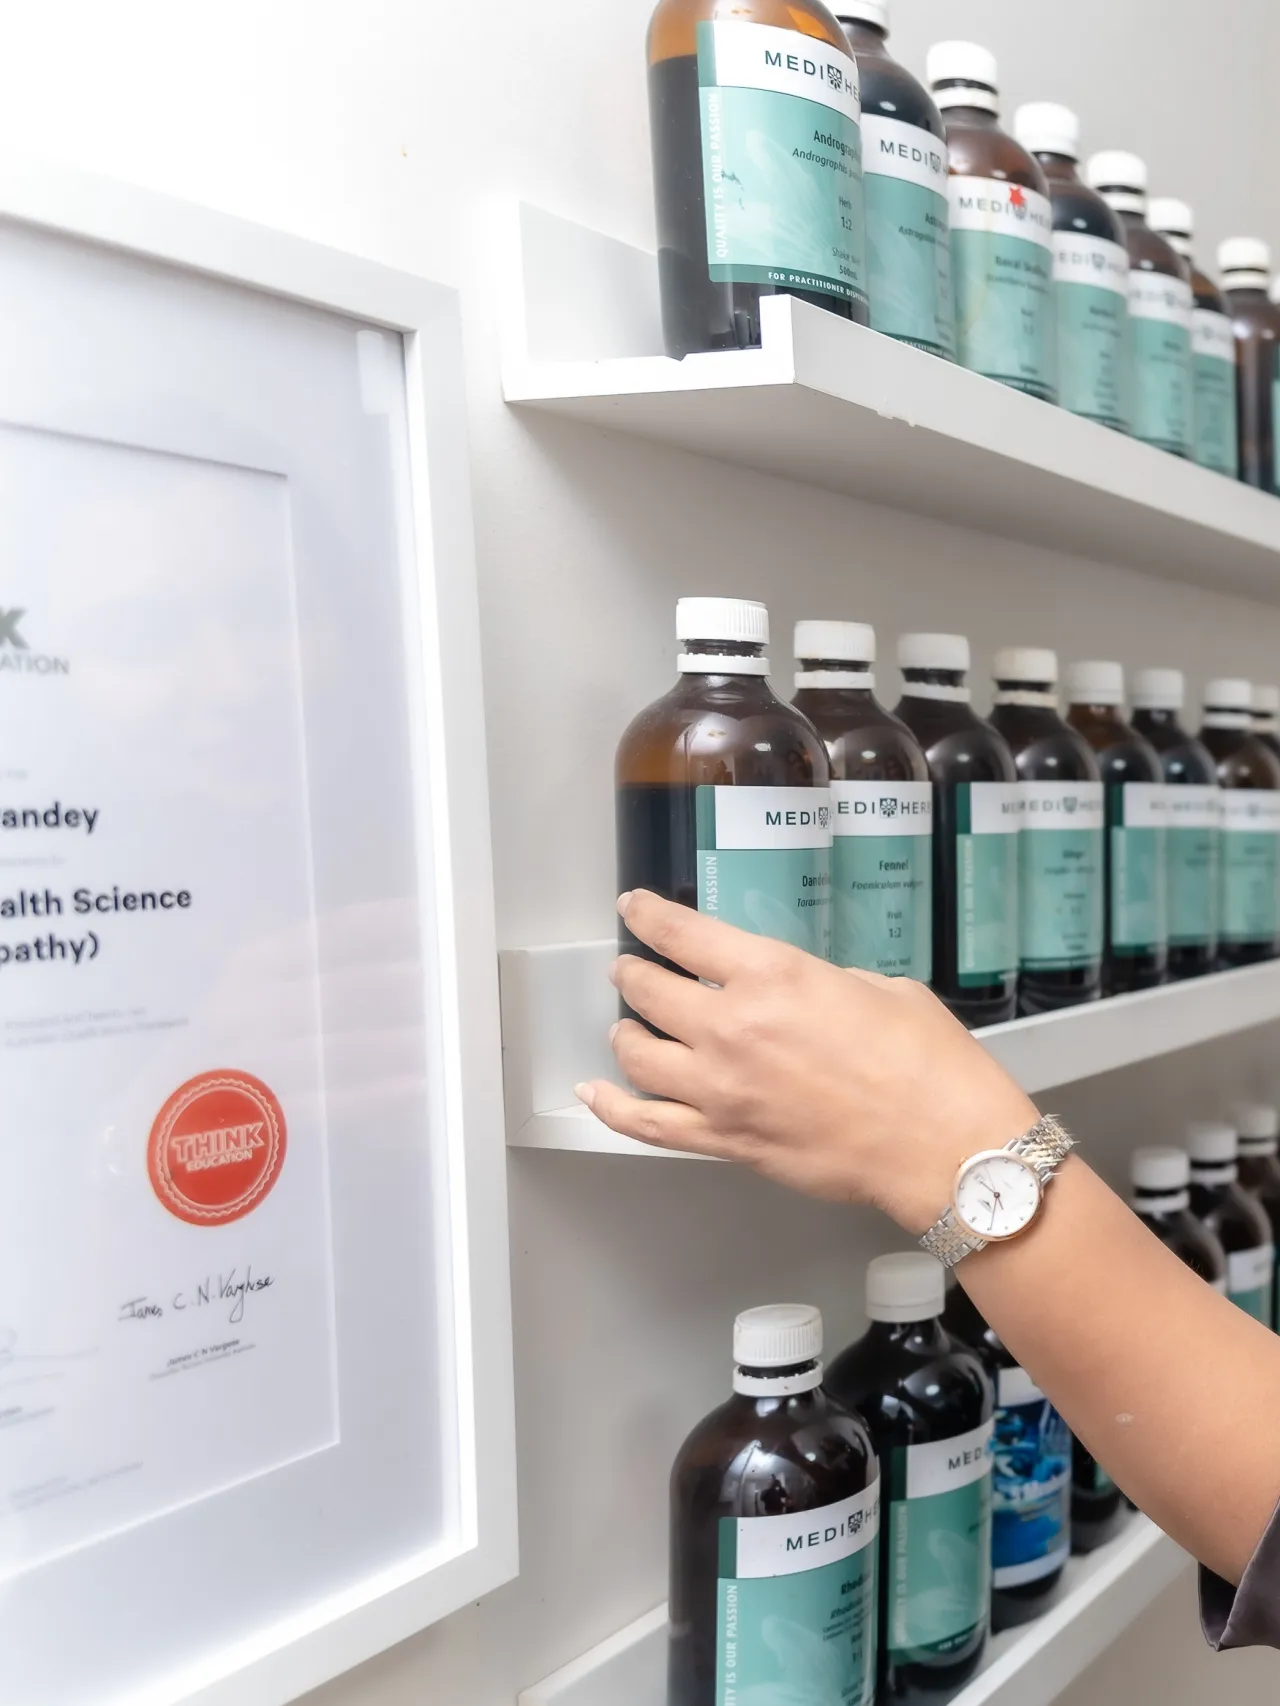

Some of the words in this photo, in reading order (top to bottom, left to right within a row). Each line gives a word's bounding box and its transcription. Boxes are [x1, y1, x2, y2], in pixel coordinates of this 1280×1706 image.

[765, 49, 824, 80] MEDI
[845, 78, 861, 102] HE
[707, 93, 722, 151] PASSION
[880, 138, 928, 168] MEDI
[711, 155, 723, 183] OUR
[713, 187, 724, 199] IS
[959, 196, 1010, 216] MEDI
[713, 204, 729, 258] QUALITY
[768, 271, 786, 281] FOR
[789, 274, 845, 294] PRACTITIONER
[766, 811, 816, 826] MEDI
[838, 801, 875, 814] EDI
[879, 860, 909, 871] Fennel
[705, 856, 718, 910] PASSION
[73, 886, 192, 914] Science
[171, 1122, 264, 1164] THINK
[186, 1149, 253, 1173] EDUCATION
[948, 1447, 984, 1471] MED
[786, 1523, 844, 1552] MEDI
[726, 1585, 738, 1638] PASSION
[725, 1641, 737, 1668] OUR
[725, 1672, 736, 1683] IS
